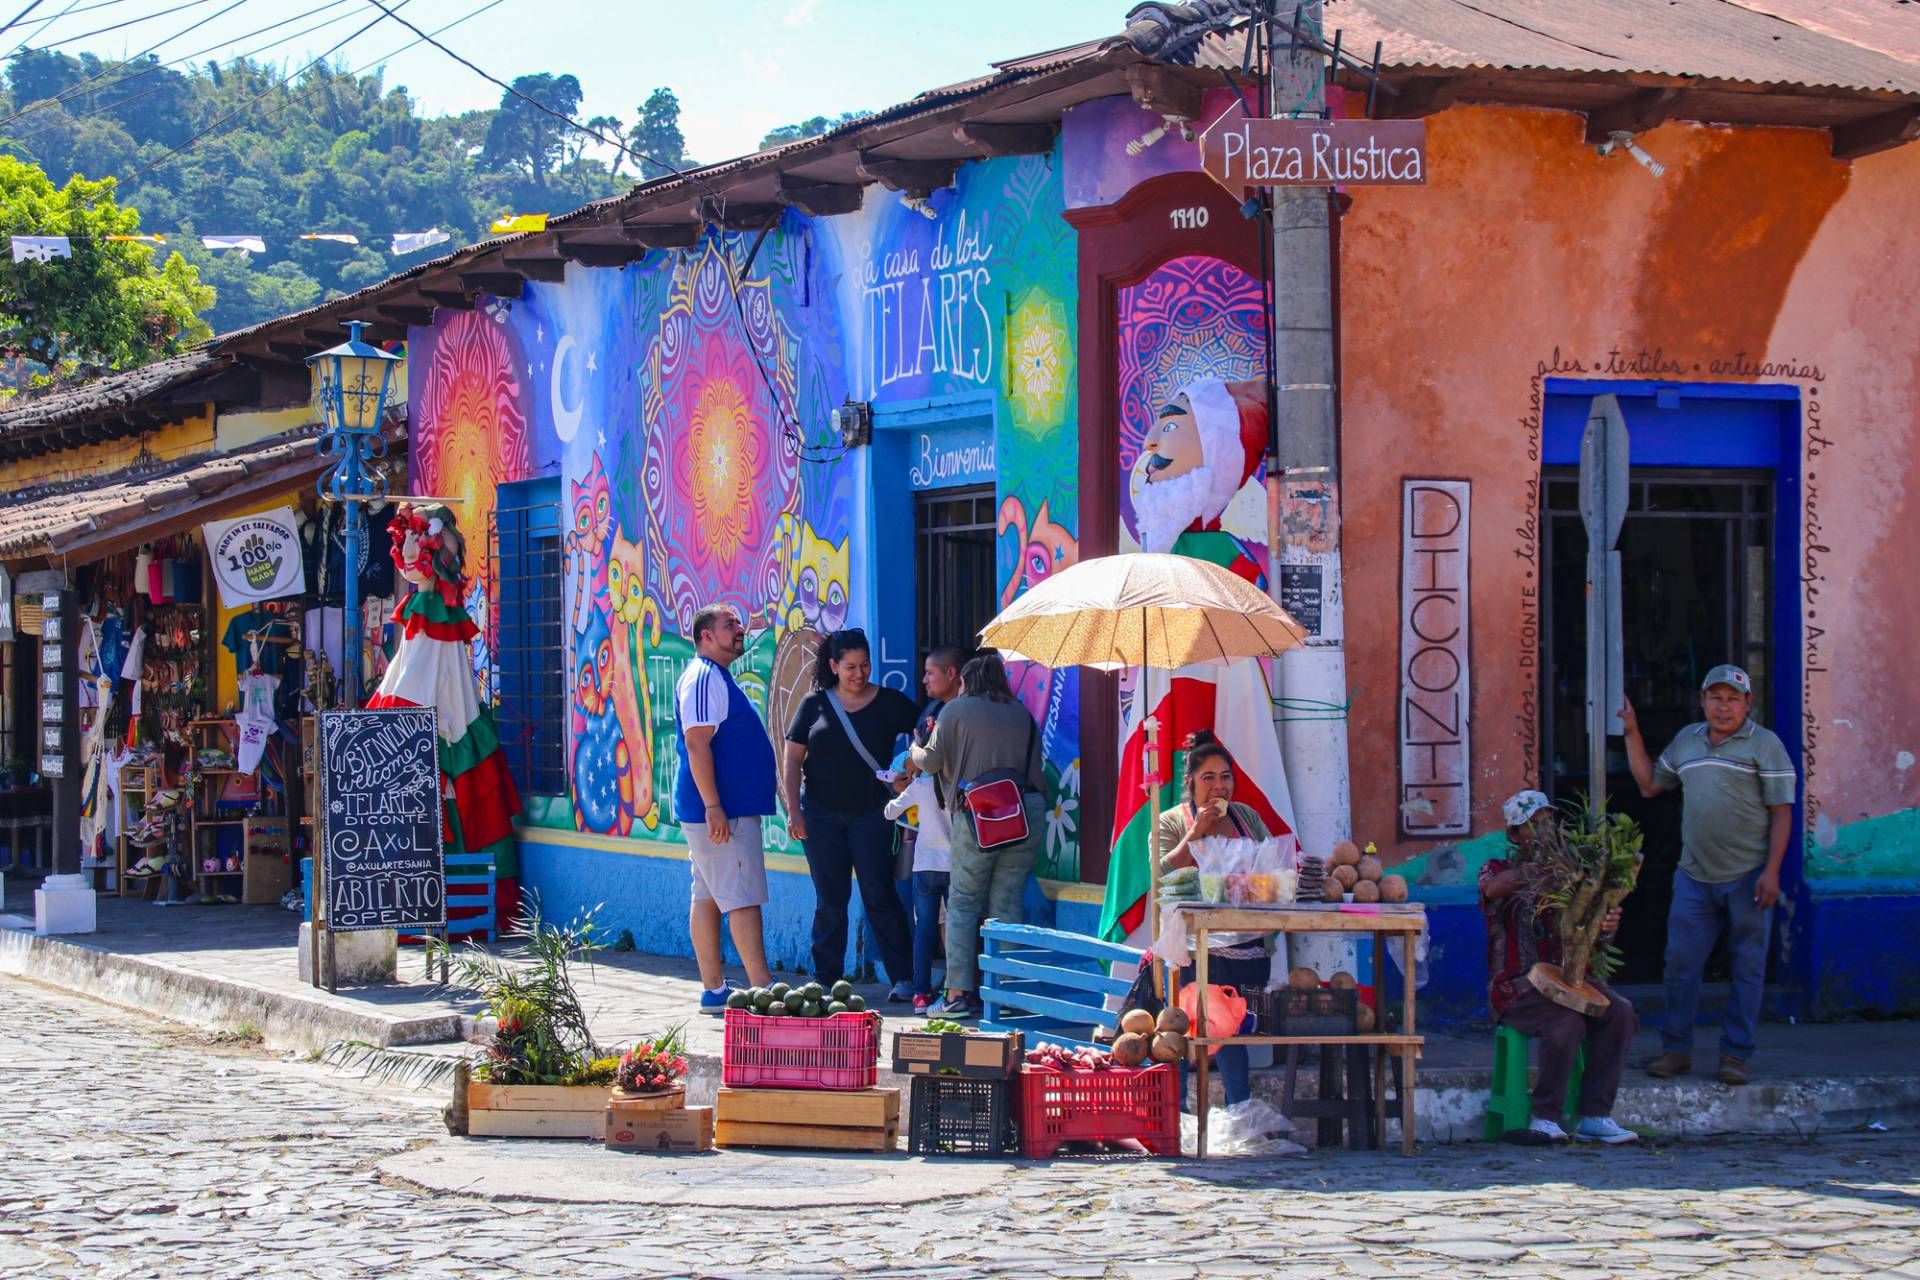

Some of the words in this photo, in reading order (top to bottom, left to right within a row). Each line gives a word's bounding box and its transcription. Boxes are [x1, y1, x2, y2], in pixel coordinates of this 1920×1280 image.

[1223, 122, 1302, 180] Plaza
[1312, 132, 1422, 180] Rustica
[1169, 207, 1209, 229] 1910
[884, 249, 920, 279] casa
[930, 223, 952, 270] de
[956, 208, 993, 266] los
[861, 267, 992, 401] TELARES
[1603, 346, 1689, 375] textiles
[1710, 348, 1827, 382] artesanias
[1806, 400, 1835, 461] arte
[909, 434, 996, 487] Bienvenid
[1513, 470, 1538, 567] telares
[219, 534, 233, 556] MADE
[232, 528, 241, 536] IN
[242, 524, 251, 532] EL
[253, 522, 289, 540] SALVADOR
[228, 541, 282, 571] 100%
[1801, 482, 1831, 605] reciclaje
[247, 563, 271, 577] HAND
[251, 569, 275, 583] MADE
[1519, 586, 1537, 668] DICONTE
[335, 738, 433, 793] welcome
[341, 790, 427, 816] TELARES
[344, 813, 430, 826] DICONTE
[345, 859, 433, 873] @AXULARTESANIA
[333, 876, 441, 912] ABIERTO
[341, 908, 420, 925] OPEN
